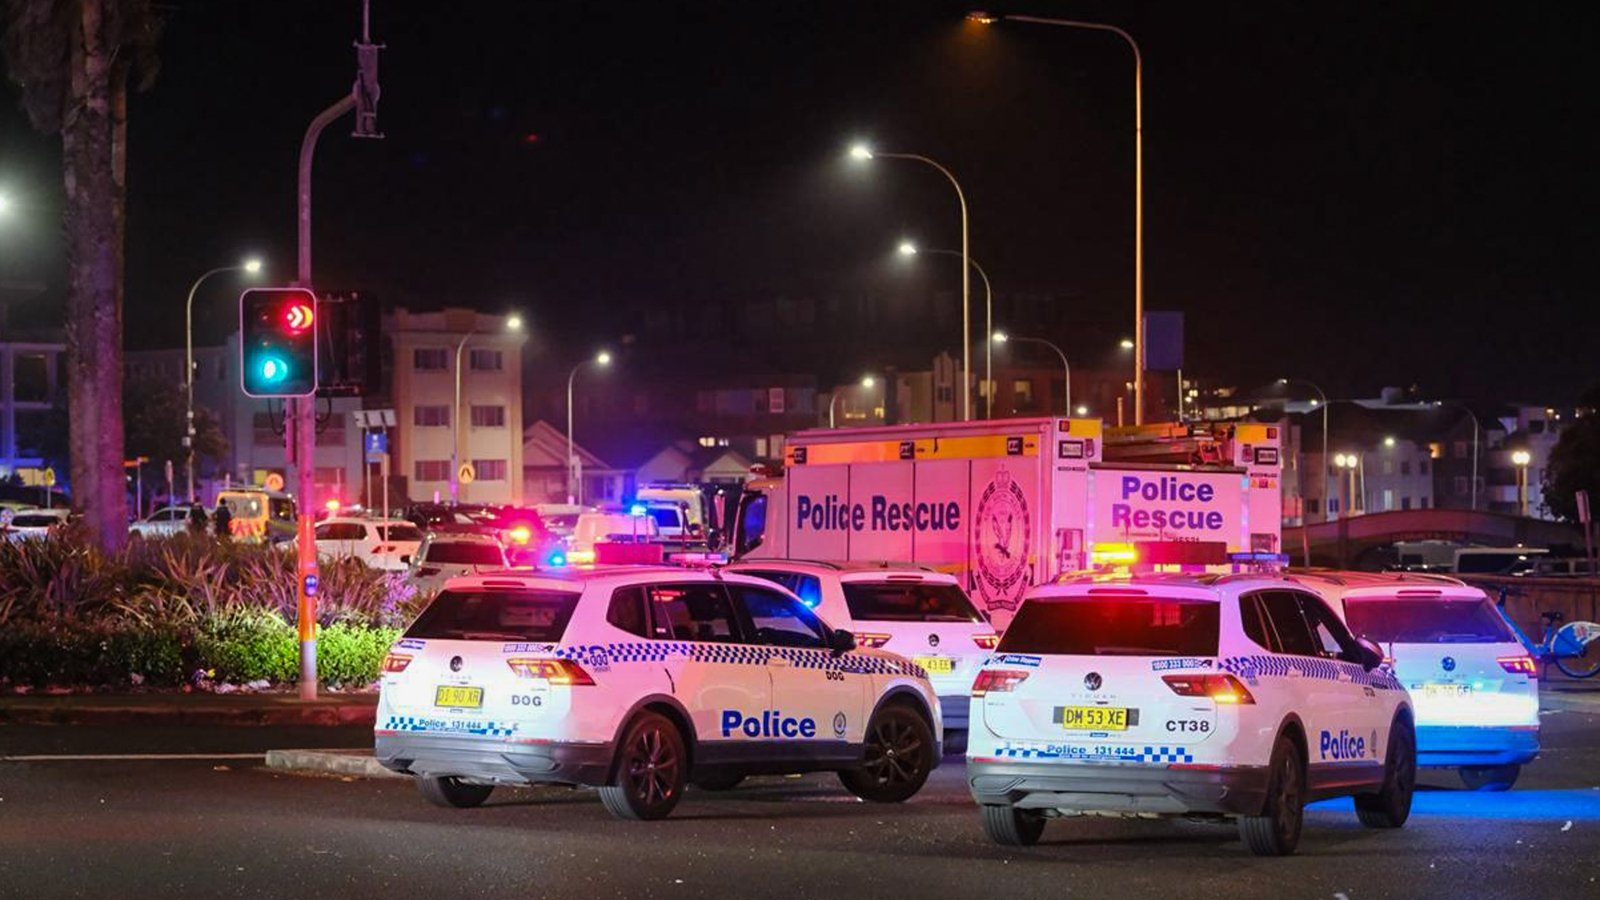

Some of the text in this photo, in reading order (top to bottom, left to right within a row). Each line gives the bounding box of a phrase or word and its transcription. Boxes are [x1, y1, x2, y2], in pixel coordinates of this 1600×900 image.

[1121, 476, 1214, 502] Police
[796, 494, 961, 531] Police Rescue
[1111, 503, 1224, 530] Rescue
[511, 694, 542, 707] DOG
[418, 718, 447, 729] Police
[721, 709, 817, 738] Police
[1065, 708, 1125, 726] DM 53 XE
[1165, 720, 1210, 733] CT38
[1046, 744, 1087, 755] Police
[1320, 729, 1366, 760] Police
